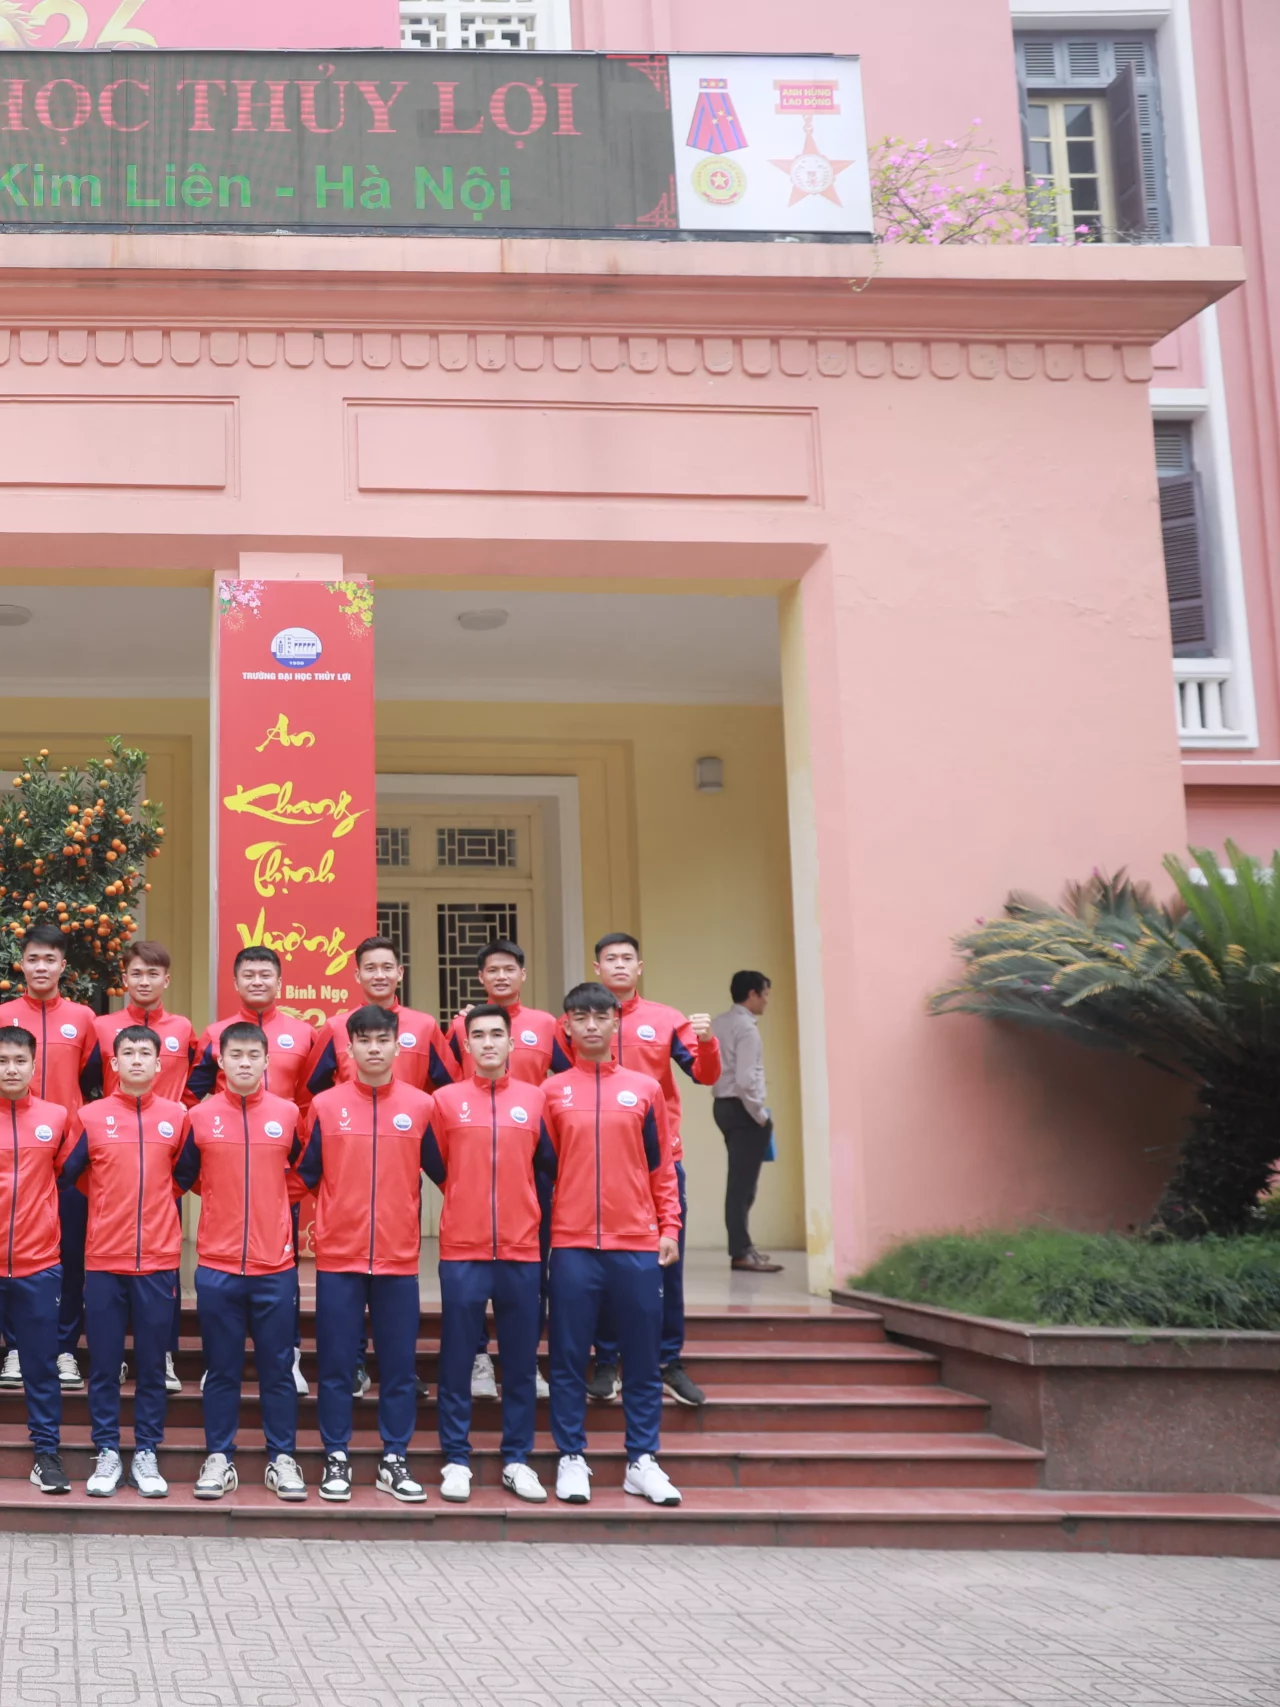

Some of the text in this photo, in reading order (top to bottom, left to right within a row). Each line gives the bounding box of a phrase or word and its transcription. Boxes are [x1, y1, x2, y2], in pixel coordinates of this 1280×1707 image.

[782, 88, 803, 96] ANH
[176, 63, 410, 135] THỦY
[432, 77, 582, 149] LỢI
[782, 98, 803, 106] LAO
[126, 163, 252, 209] Liên
[275, 185, 295, 197] -
[315, 164, 393, 210] Hà
[416, 164, 513, 222] Nội
[294, 672, 312, 682] HỌC
[255, 712, 316, 753] An
[223, 781, 370, 838] Khang
[245, 841, 336, 898] Thịnh
[236, 906, 357, 976] Vượng
[285, 984, 317, 1000] Bính
[320, 984, 349, 1004] Ngọ
[13, 1017, 19, 1027] 9
[341, 1108, 347, 1117] 5
[106, 1116, 115, 1125] 10
[215, 1116, 220, 1125] 3
